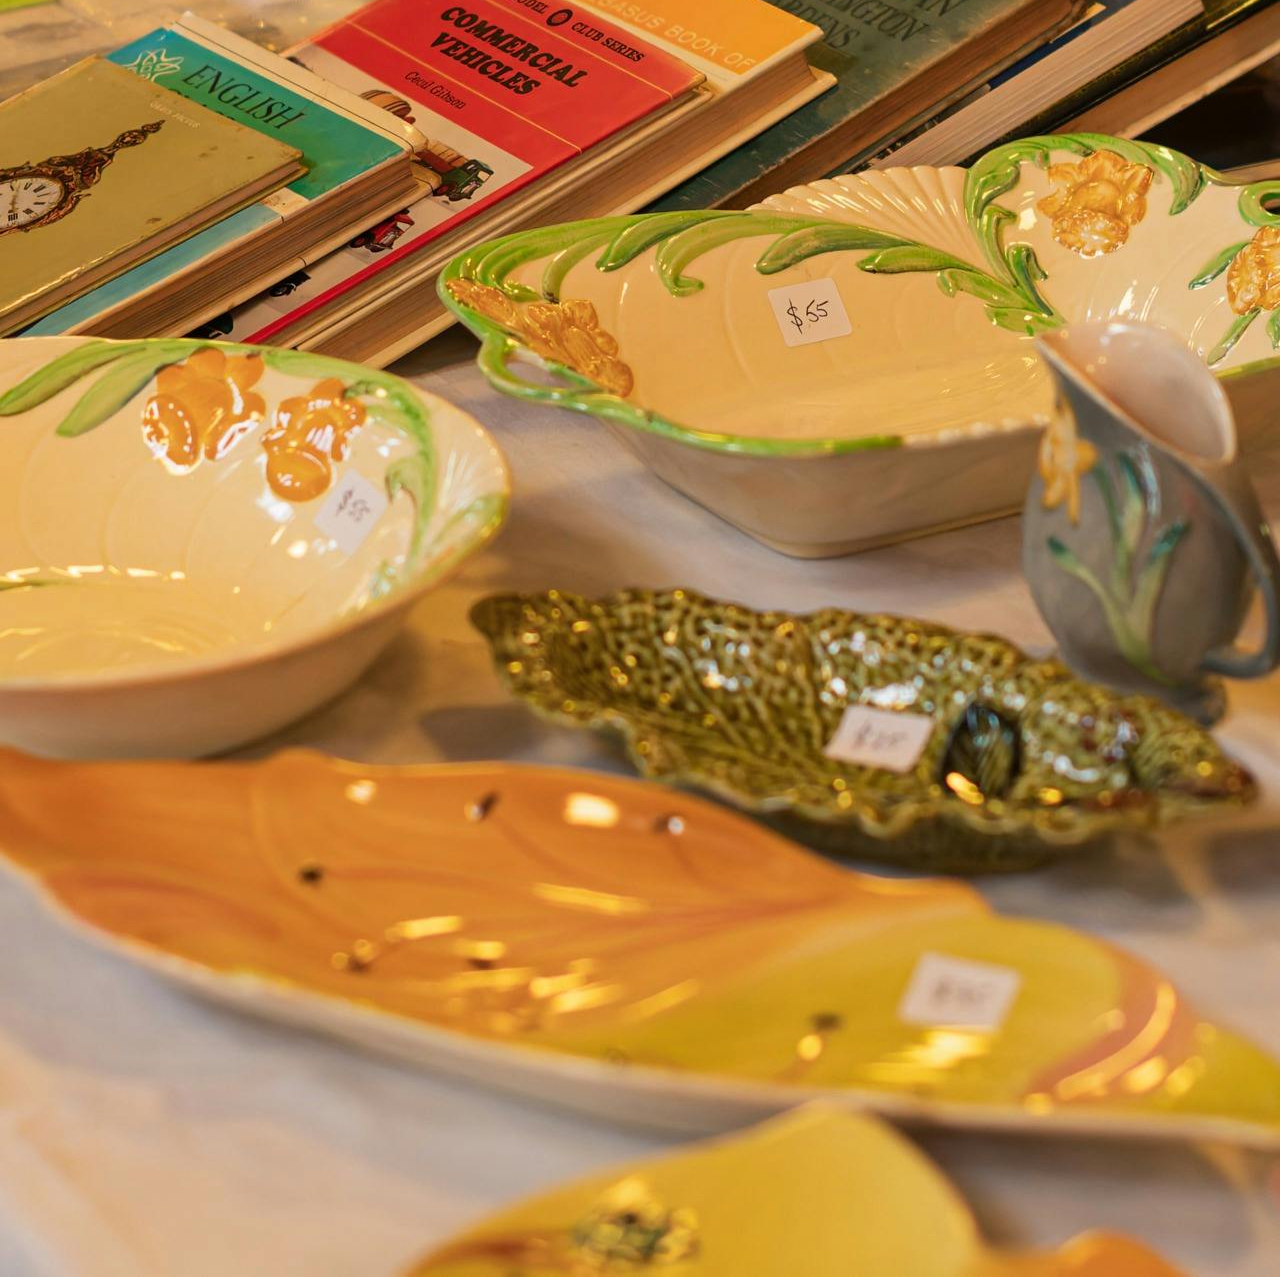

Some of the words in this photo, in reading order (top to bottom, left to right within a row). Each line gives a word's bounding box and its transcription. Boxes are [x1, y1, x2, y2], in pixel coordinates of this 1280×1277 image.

[430, 31, 542, 95] VEHICLES
[440, 6, 589, 88] COMMERCIAL
[571, 21, 605, 42] CLUB
[600, 36, 646, 63] SERIES
[663, 24, 723, 57] BOOK
[722, 50, 757, 69] OF
[181, 64, 308, 130] ENGLISH
[429, 85, 467, 109] Gibson
[786, 298, 829, 334] $55
